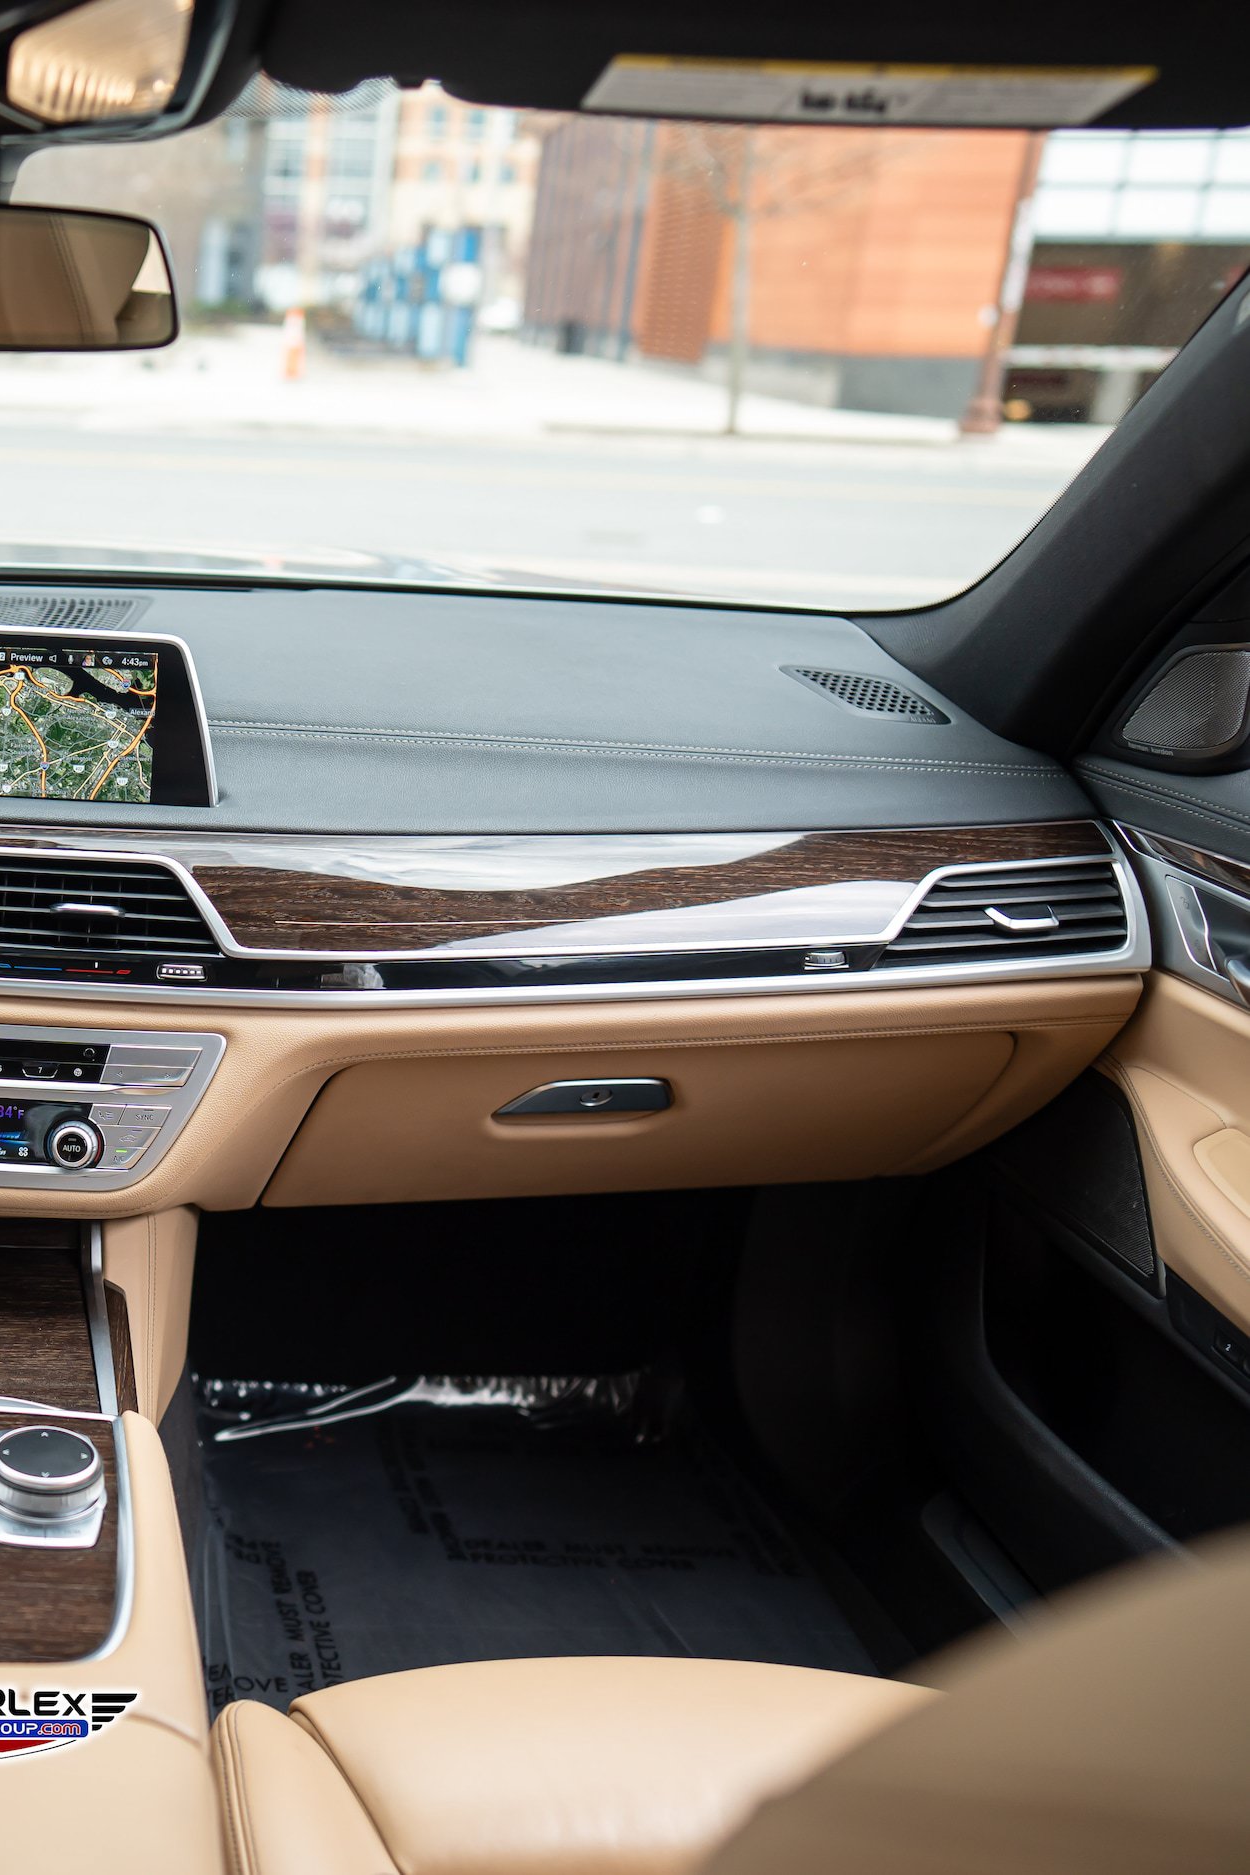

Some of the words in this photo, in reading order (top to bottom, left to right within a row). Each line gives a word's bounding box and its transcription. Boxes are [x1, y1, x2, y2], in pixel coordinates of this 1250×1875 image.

[10, 652, 43, 663] Preview
[121, 657, 149, 667] 4:43pm
[37, 1066, 43, 1074] 7
[135, 1113, 155, 1121] SYNC
[62, 1144, 81, 1153] AUTO
[261, 1540, 293, 1595] REMOVE
[296, 1570, 326, 1615] COVER
[276, 1600, 305, 1642] MUST
[234, 1676, 289, 1693] OVE
